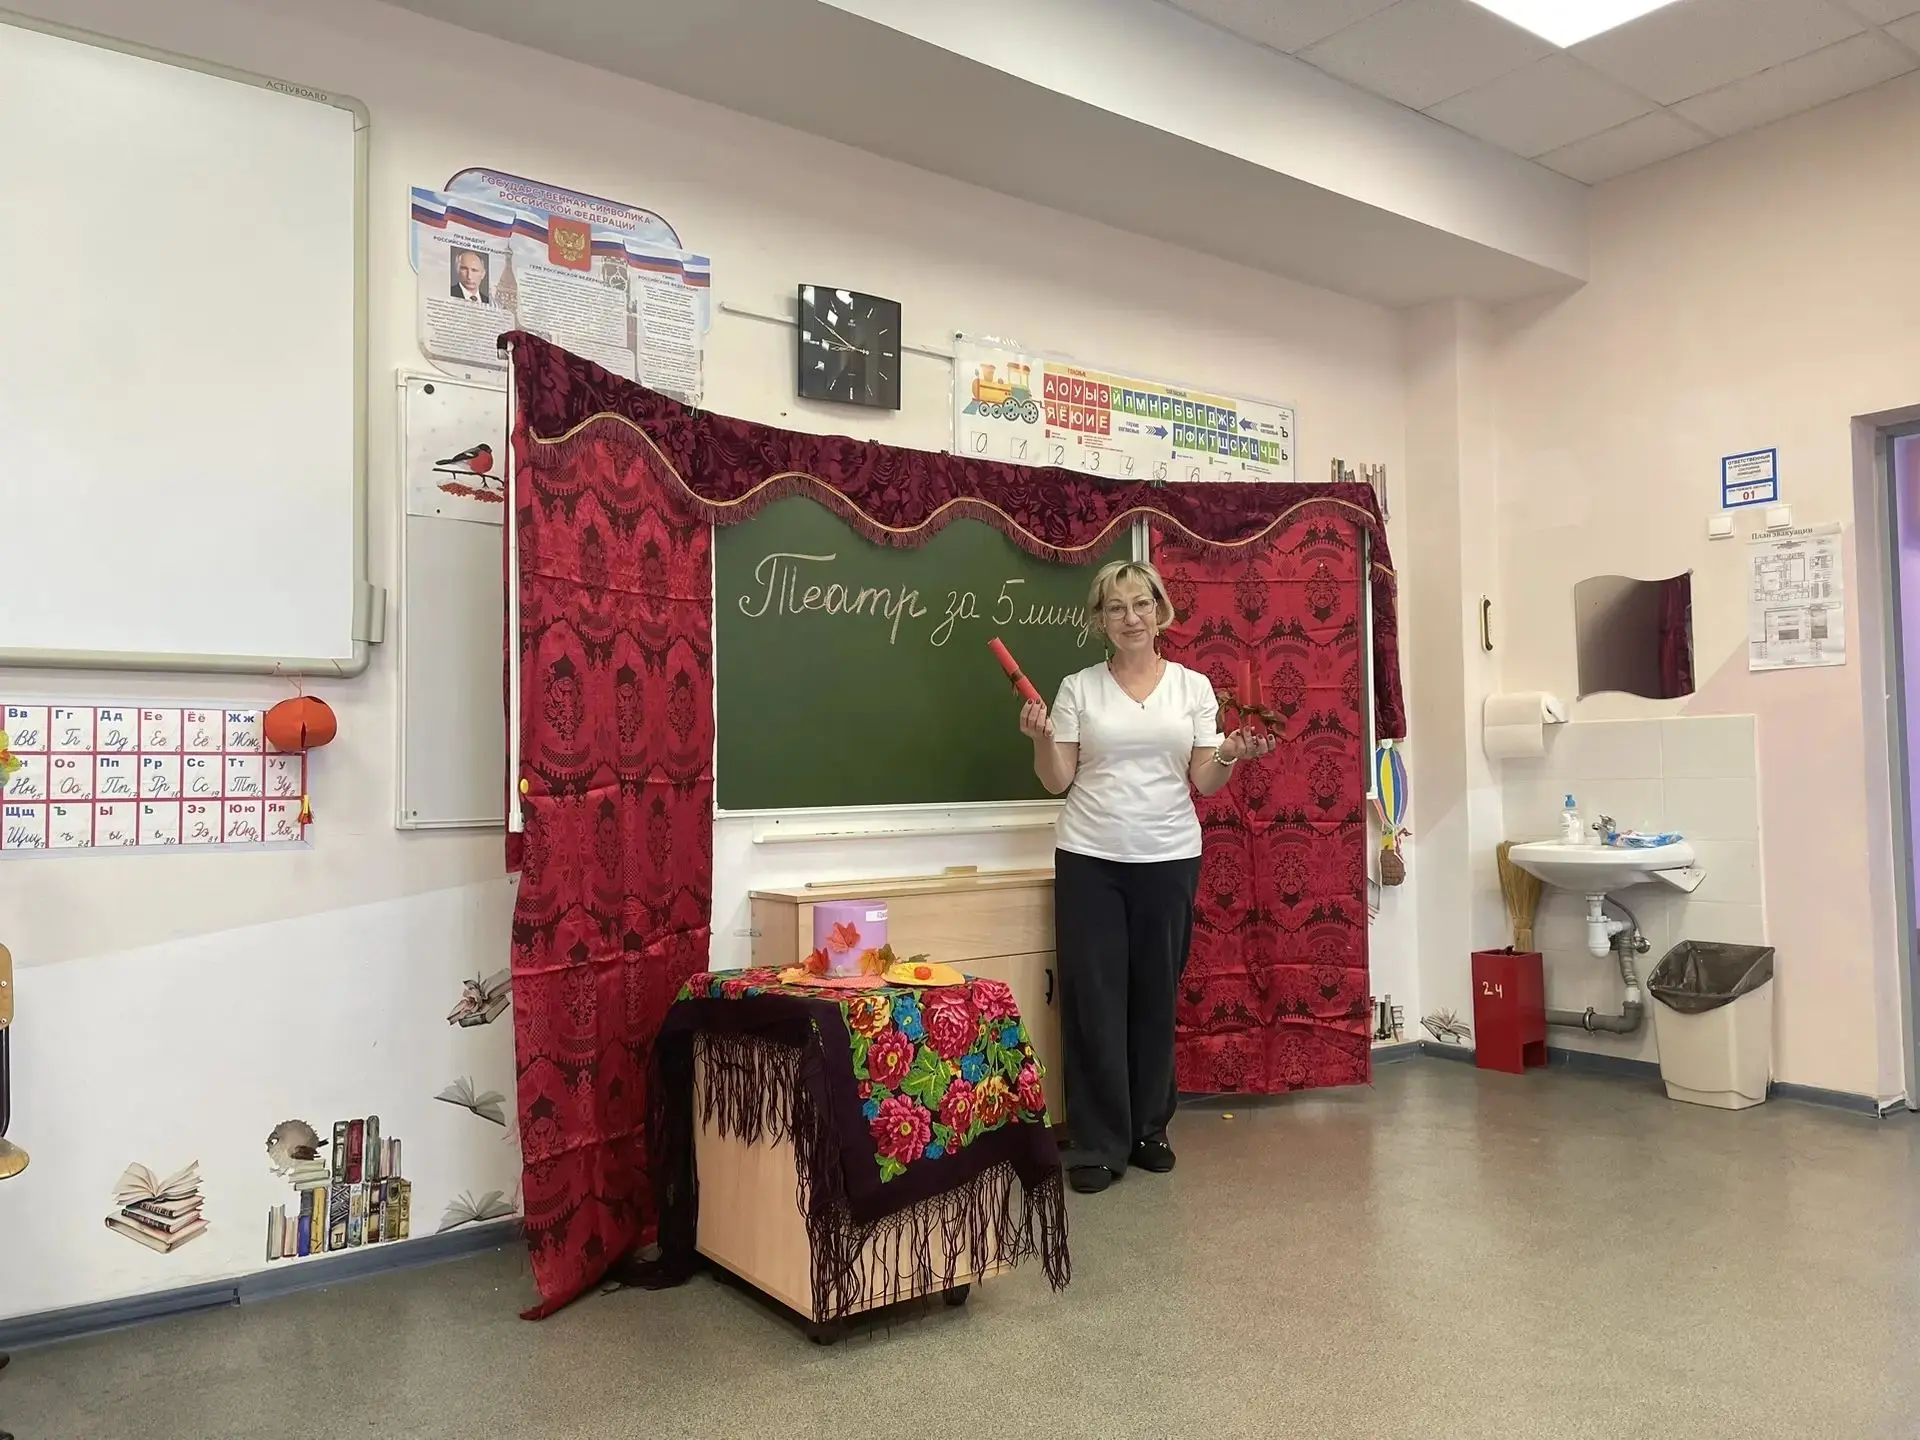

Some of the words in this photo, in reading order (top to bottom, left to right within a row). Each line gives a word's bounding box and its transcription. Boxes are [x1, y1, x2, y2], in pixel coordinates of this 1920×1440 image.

[266, 80, 327, 101] ACTIVBOARD
[481, 175, 587, 208] ГОСУДАРСТВЕННАЯ
[590, 202, 651, 225] СИМВОЛИКА
[499, 191, 572, 216] РОССИЙСКОЙ
[574, 209, 636, 231] ФЕДЕРАЦИИ
[976, 432, 988, 453] 0
[1018, 439, 1028, 459] 1
[1054, 445, 1065, 465] 2
[1090, 451, 1100, 471] 3
[1125, 456, 1134, 476] 4
[1742, 490, 1755, 500] 01
[1751, 532, 1771, 540] План
[1772, 528, 1813, 537] эвакуации
[738, 552, 927, 645] Театр
[930, 590, 980, 647] за
[992, 578, 1025, 625] 5
[1018, 602, 1089, 648] мину
[8, 708, 28, 718] Вв
[55, 709, 74, 719] Гг
[100, 710, 123, 722] Дд
[144, 711, 163, 722] Ее
[187, 711, 206, 723] Ёё
[228, 713, 255, 723] Жж
[54, 758, 76, 768] Оо
[100, 758, 120, 768] Пп
[144, 758, 163, 770] Рр
[186, 758, 205, 768] Сс
[228, 758, 245, 768] Тт
[269, 759, 286, 770] Уу
[5, 806, 35, 818] Щщ
[187, 804, 206, 814] Ээ
[229, 804, 256, 813] Юю
[268, 803, 285, 813] Яя
